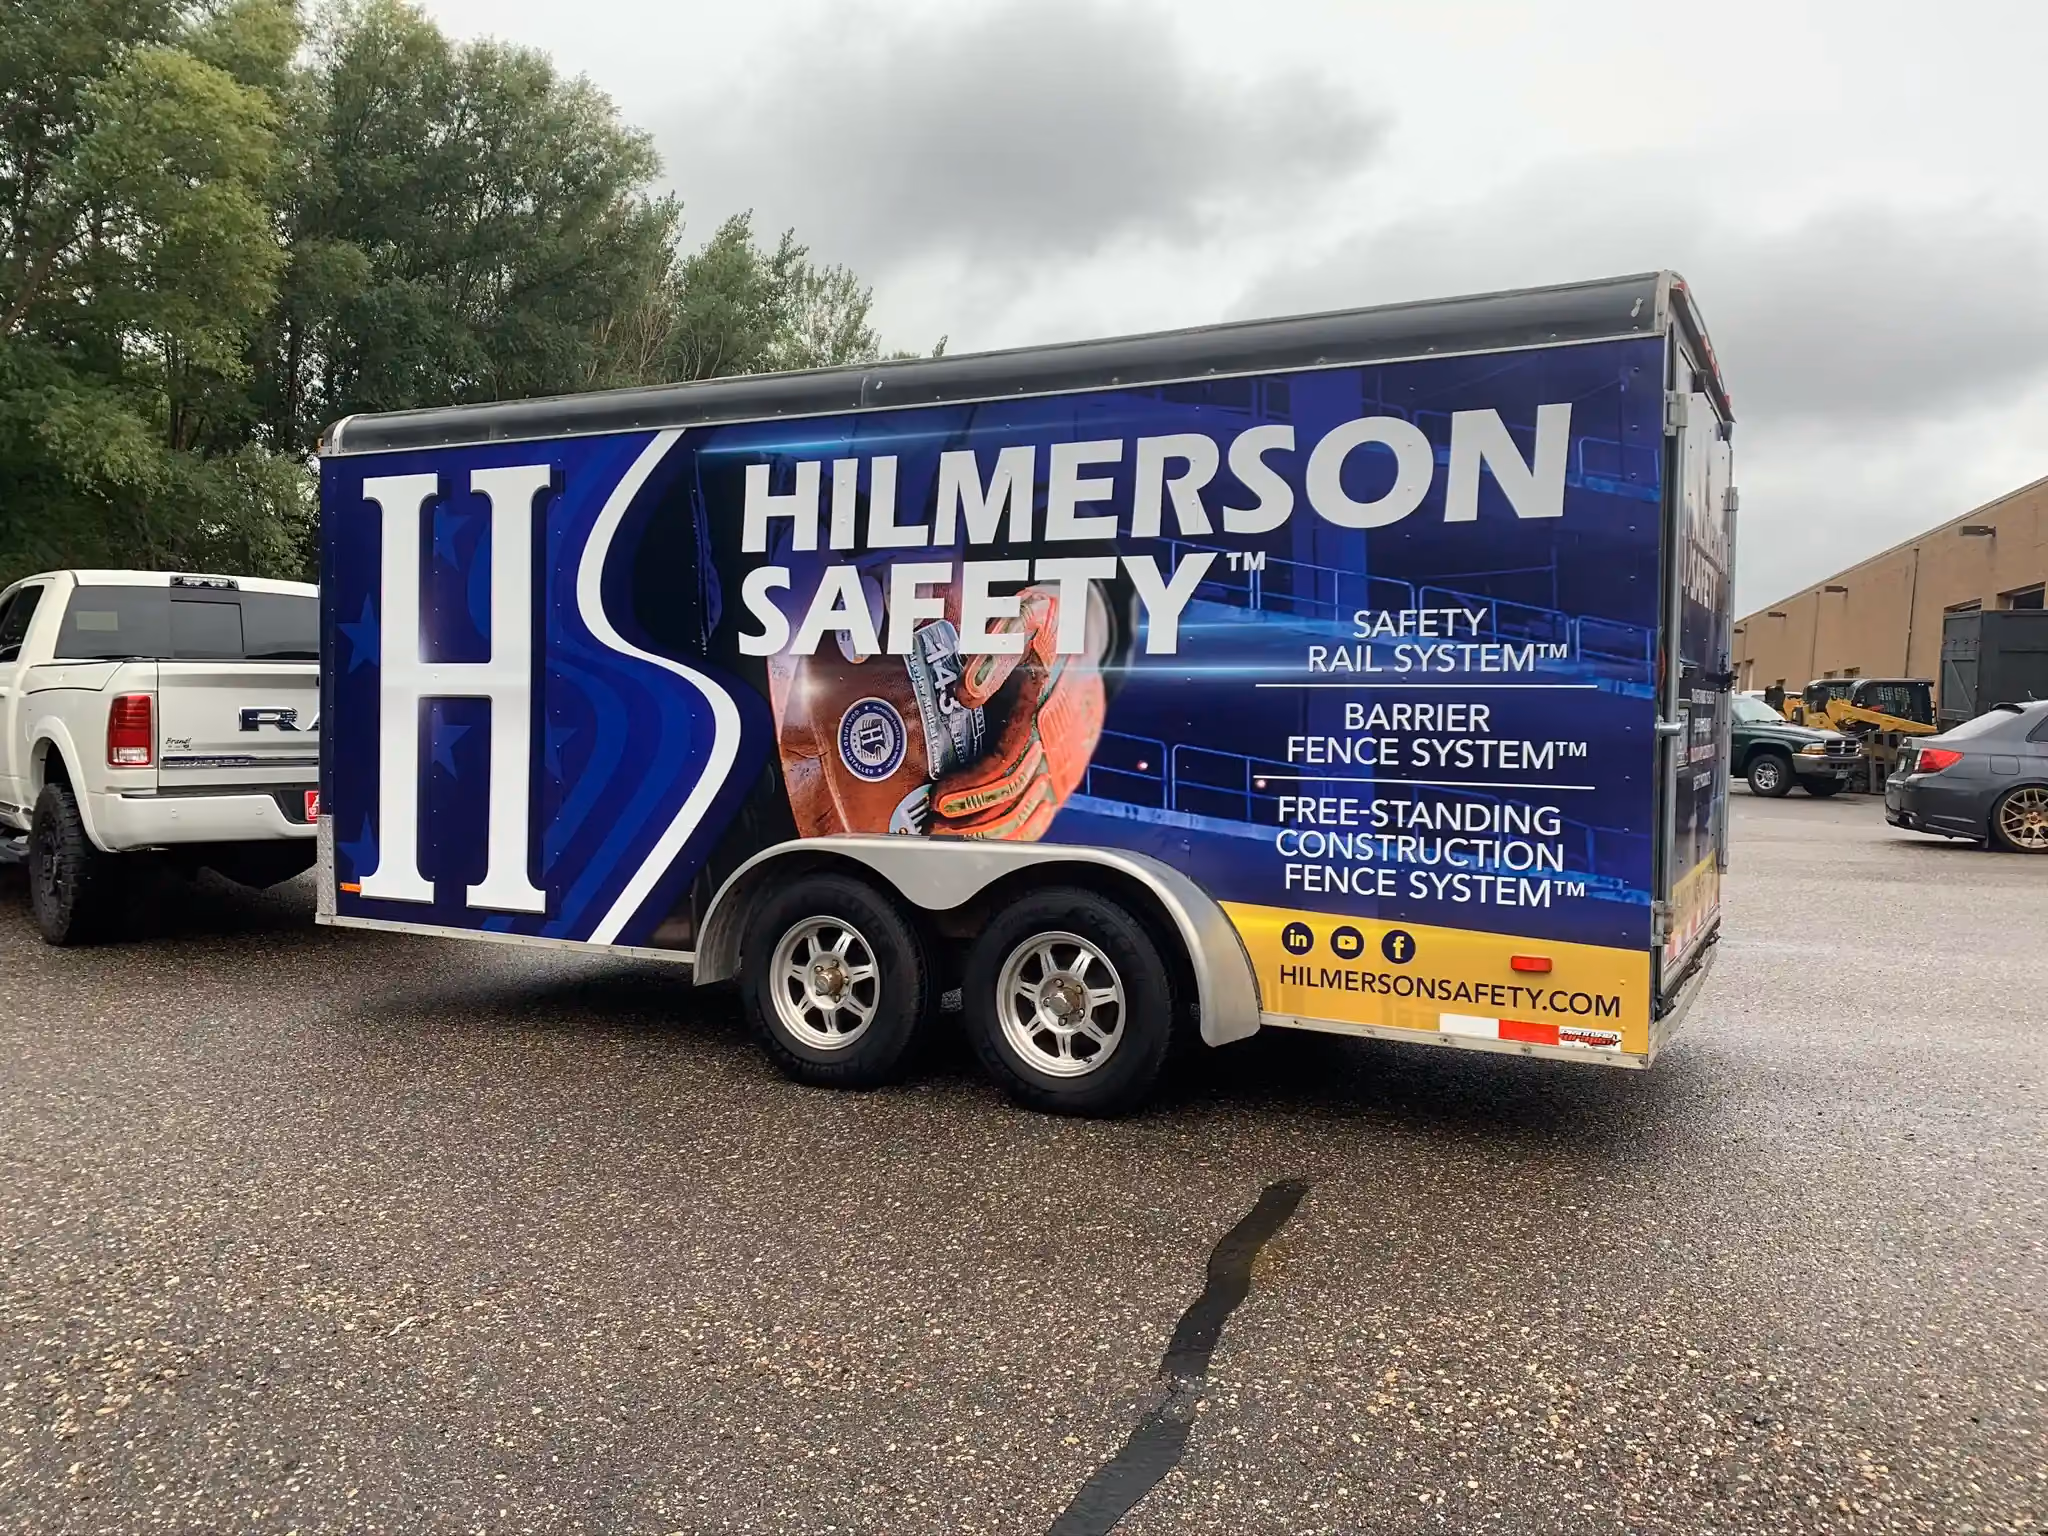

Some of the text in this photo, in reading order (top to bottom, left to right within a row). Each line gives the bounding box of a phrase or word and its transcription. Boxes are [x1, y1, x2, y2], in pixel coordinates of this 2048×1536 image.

[741, 402, 1573, 553] HILMERSON
[1353, 607, 1488, 639] SAFETY
[1308, 645, 1383, 673] RAIL
[1344, 703, 1491, 732] BARRIER
[843, 709, 874, 775] QUALIFIED INSTALLER
[1286, 736, 1400, 766] FENCE
[1278, 796, 1562, 836] FREE-STANDING
[1275, 829, 1564, 873] CONSTRUCTION
[1284, 864, 1398, 897] FENCE
[1279, 964, 1622, 1018] HILMERSONSAFETY.COM
